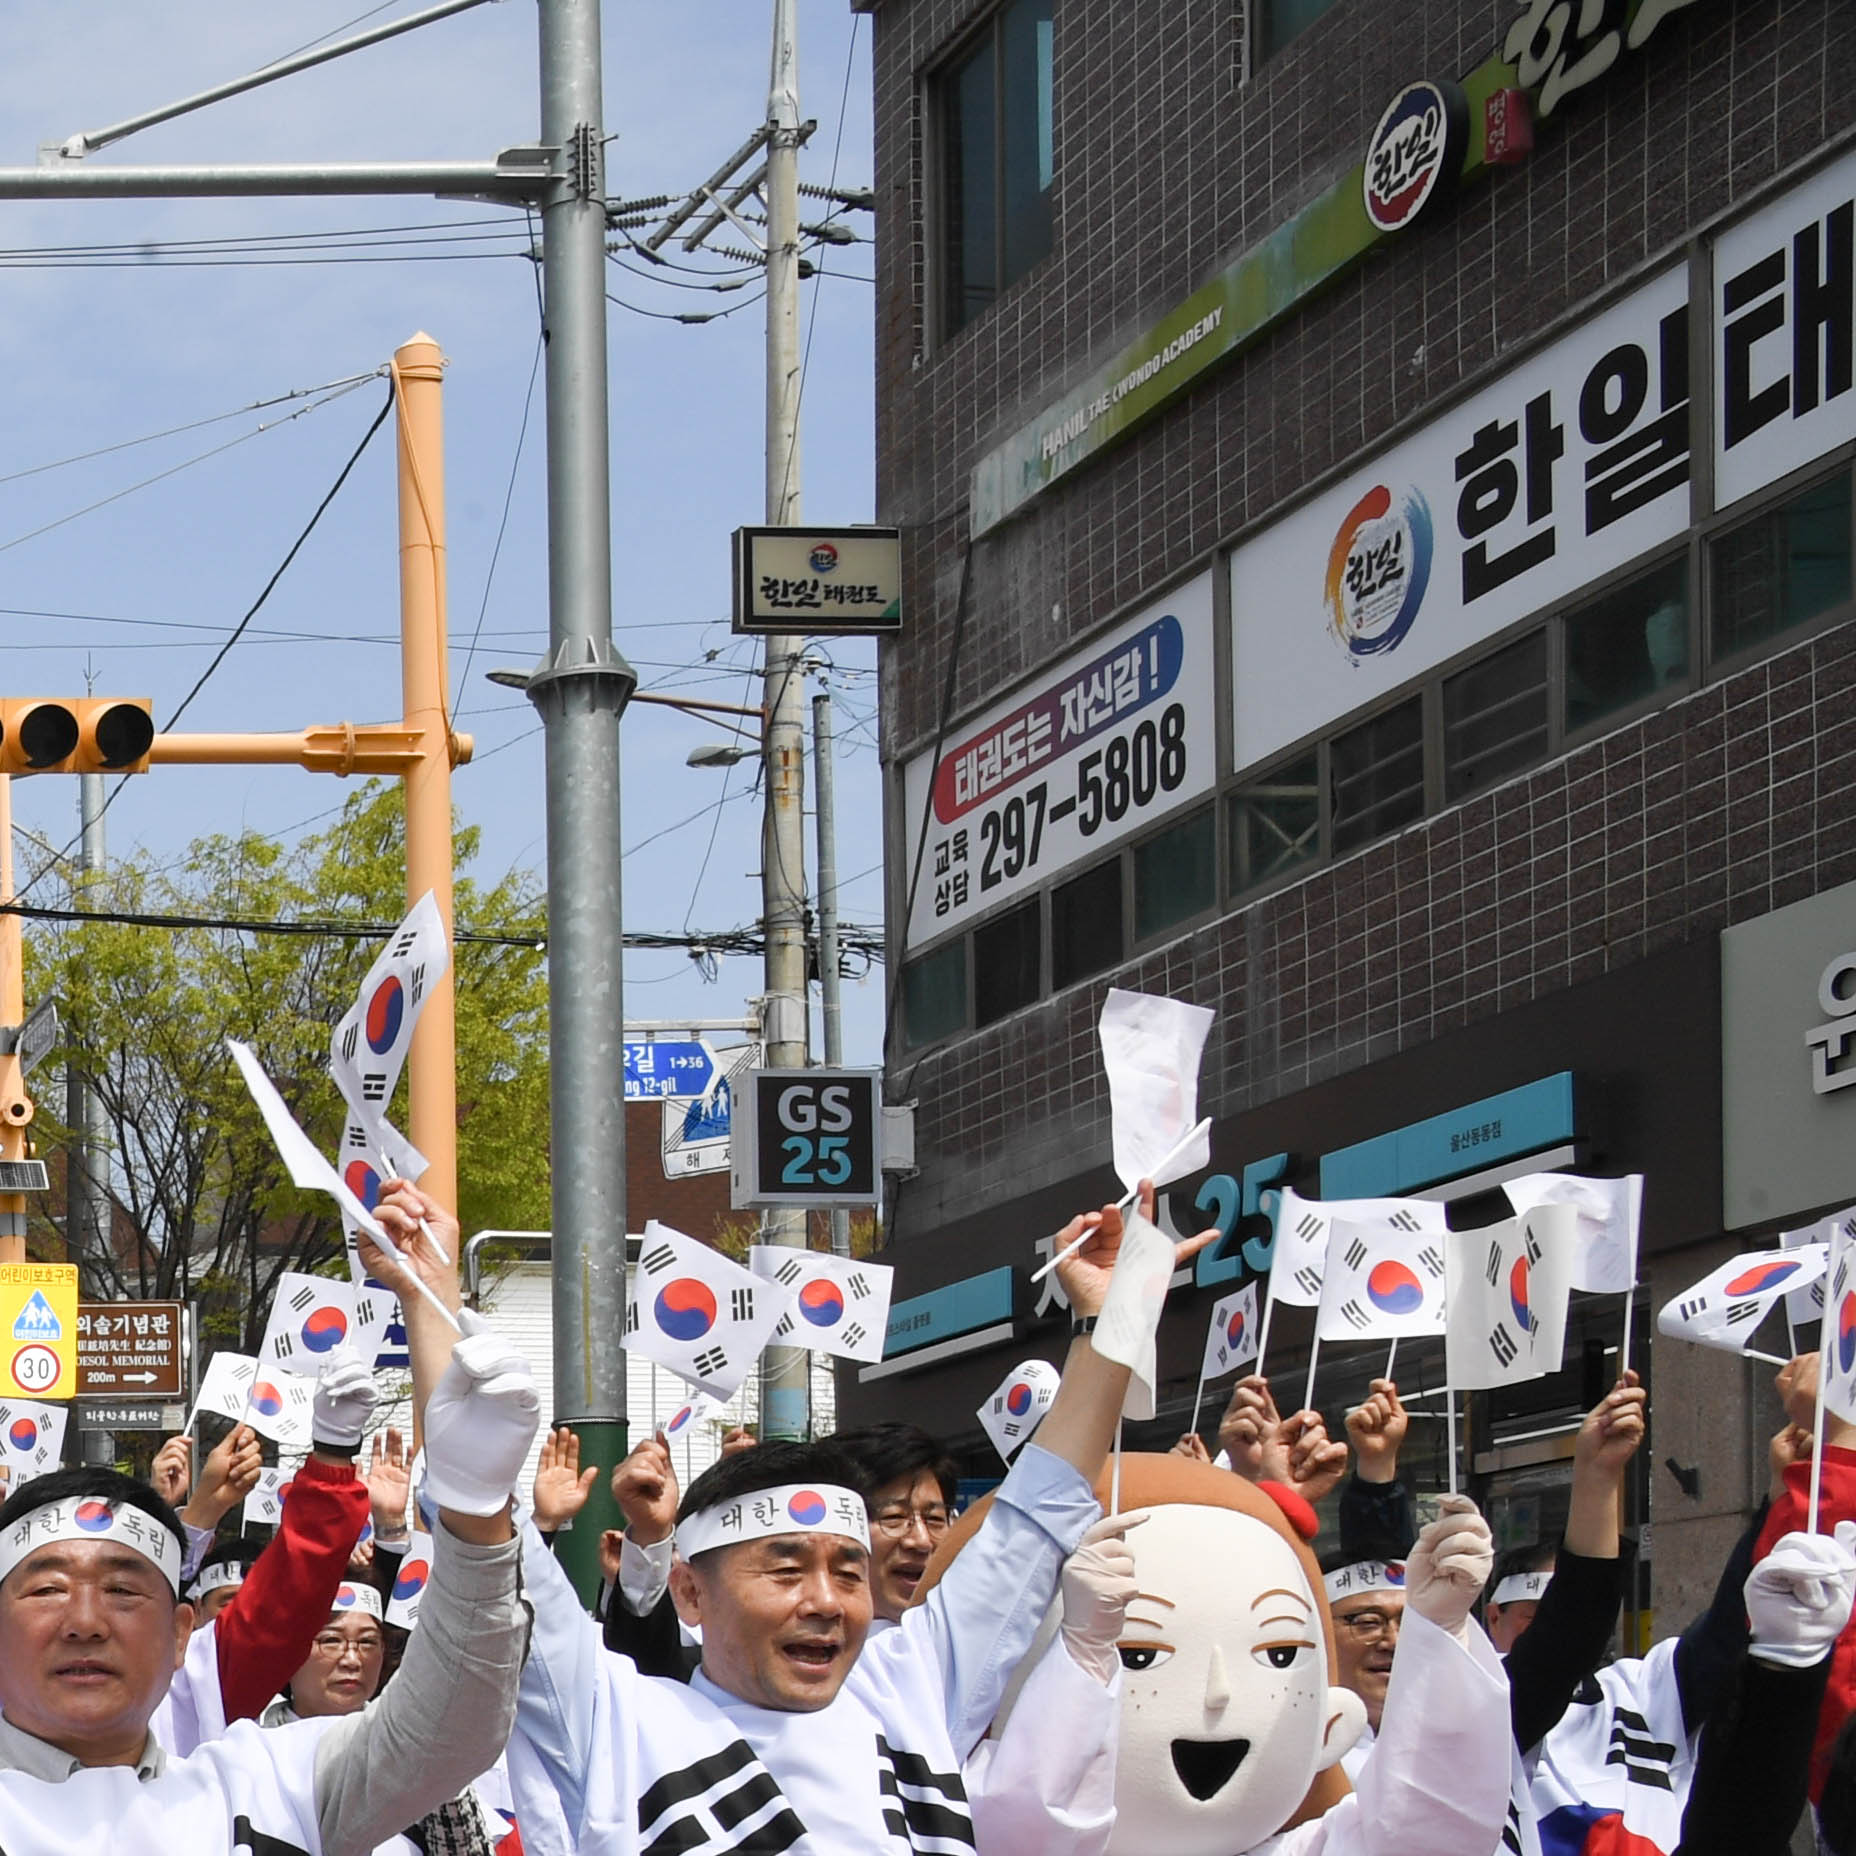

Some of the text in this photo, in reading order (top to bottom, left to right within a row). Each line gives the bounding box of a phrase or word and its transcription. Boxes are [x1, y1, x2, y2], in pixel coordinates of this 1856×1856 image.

[1042, 418, 1089, 460] HANIL
[1160, 305, 1224, 368] ACADEMY
[1345, 530, 1405, 603] 한일
[760, 575, 887, 608] 한일 태권도
[954, 709, 1053, 807] 태권도는
[979, 702, 1187, 893] 297-5808
[934, 827, 969, 878] 교육
[934, 868, 970, 918] 상담
[777, 1084, 854, 1133] GS
[780, 1135, 853, 1186] 25
[0, 1267, 76, 1287] 어린이보호구역
[76, 1313, 172, 1336] 외솔기념관
[23, 1357, 50, 1380] 30
[87, 1371, 117, 1384] 200m
[111, 1354, 171, 1367] MEMORIAL
[14, 1507, 166, 1561] 대한 독립
[720, 1496, 780, 1533] 대한
[1335, 1564, 1380, 1590] 대한
